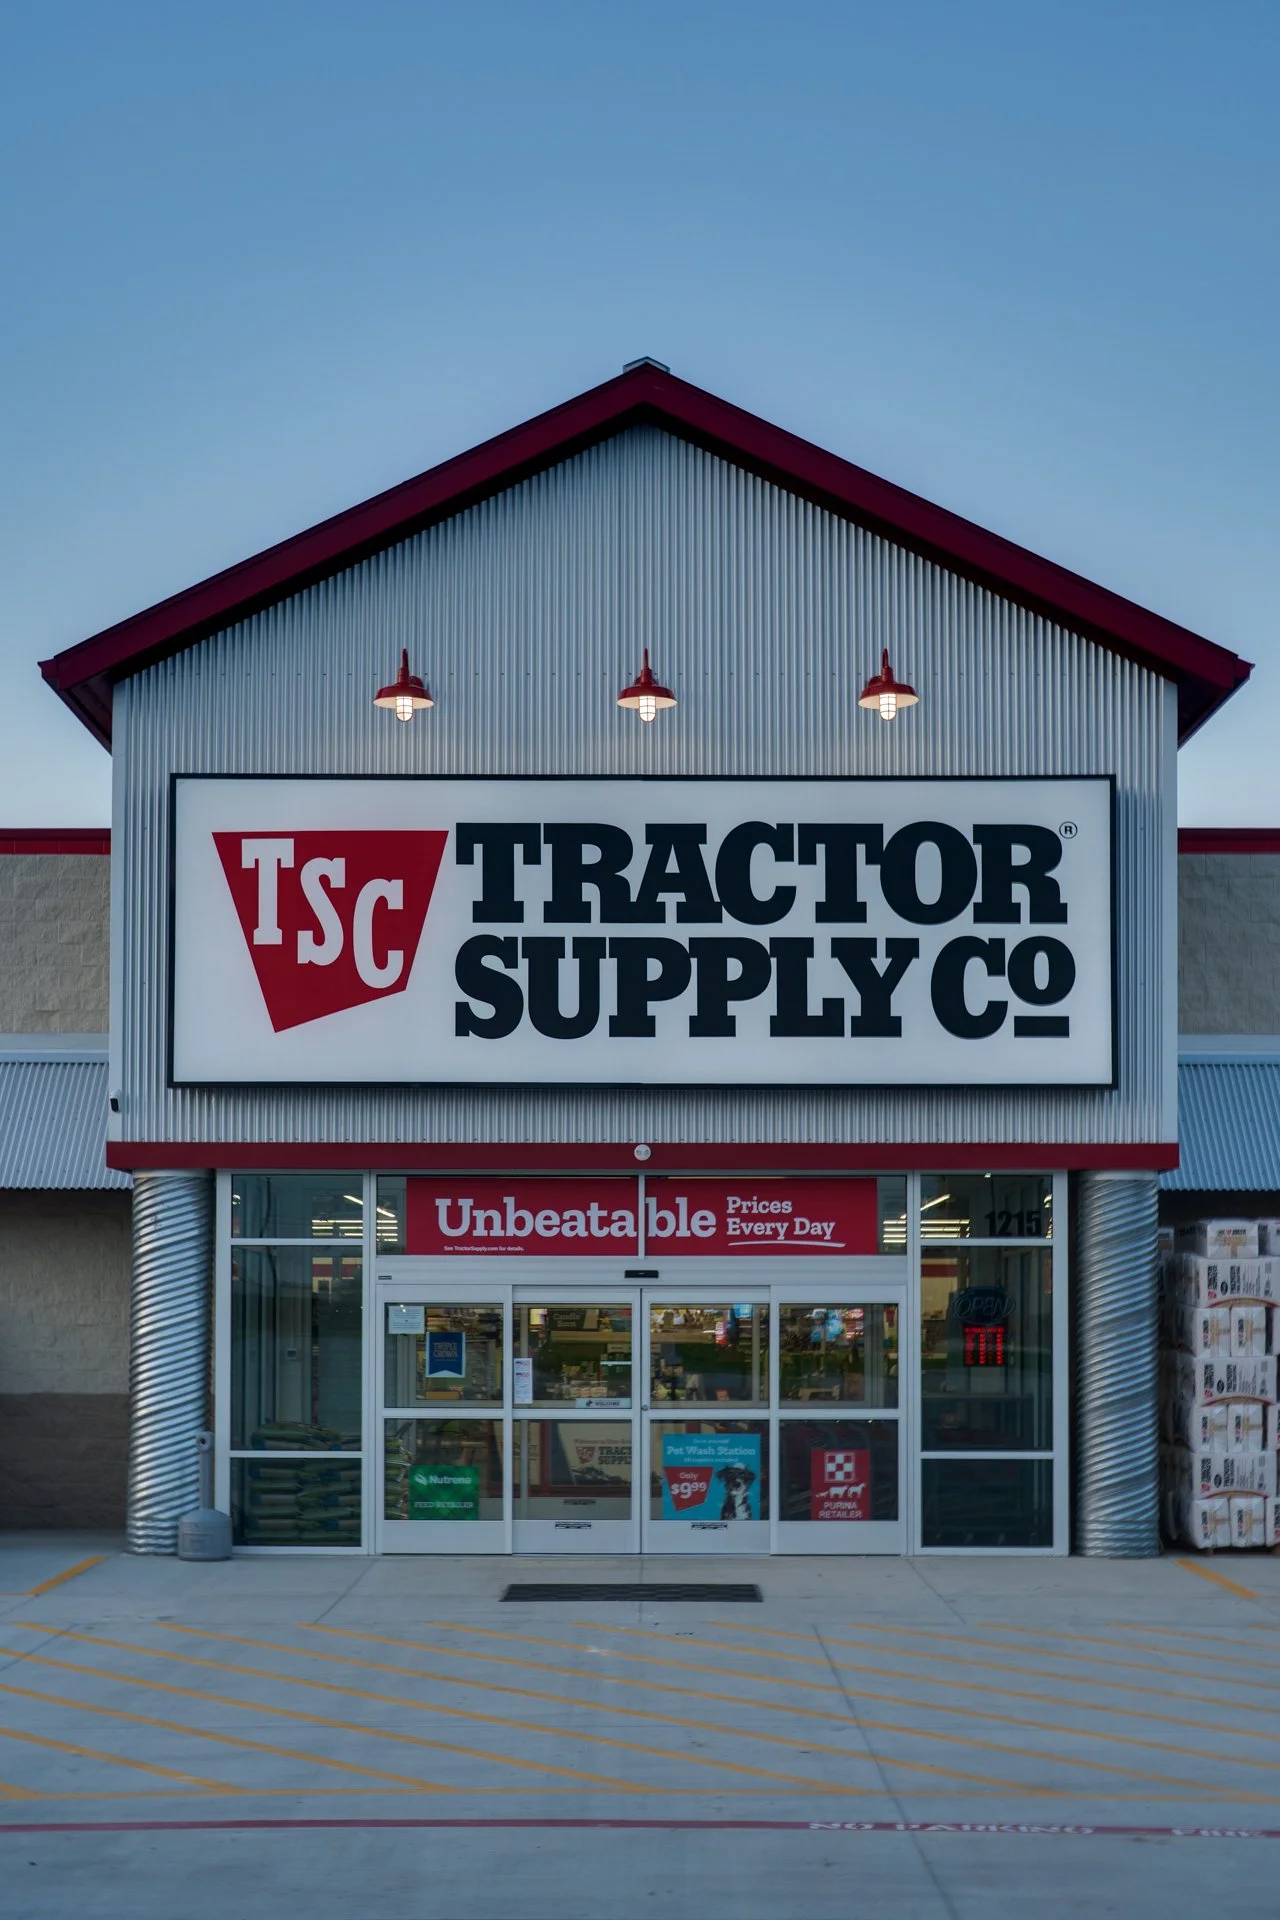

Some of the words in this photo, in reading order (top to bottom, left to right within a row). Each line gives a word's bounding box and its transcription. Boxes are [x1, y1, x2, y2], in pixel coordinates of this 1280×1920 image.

[455, 821, 1068, 925] TRACTOR
[241, 838, 404, 989] TSC
[455, 934, 920, 1039] SUPPLY
[725, 1195, 793, 1214] Prices
[435, 1196, 717, 1238] Unbeatable
[985, 1211, 1042, 1237] 1215
[725, 1217, 788, 1240] Every
[793, 1217, 836, 1240] Day
[958, 1296, 1009, 1318] OPEN
[666, 1446, 684, 1455] Pet
[685, 1446, 715, 1455] Wash
[716, 1446, 756, 1456] Station
[678, 1472, 699, 1480] Only
[818, 1510, 862, 1519] RETAILER
[823, 1501, 857, 1510] PURINA
[809, 1822, 873, 1831] NO
[894, 1823, 1095, 1834] PARKING
